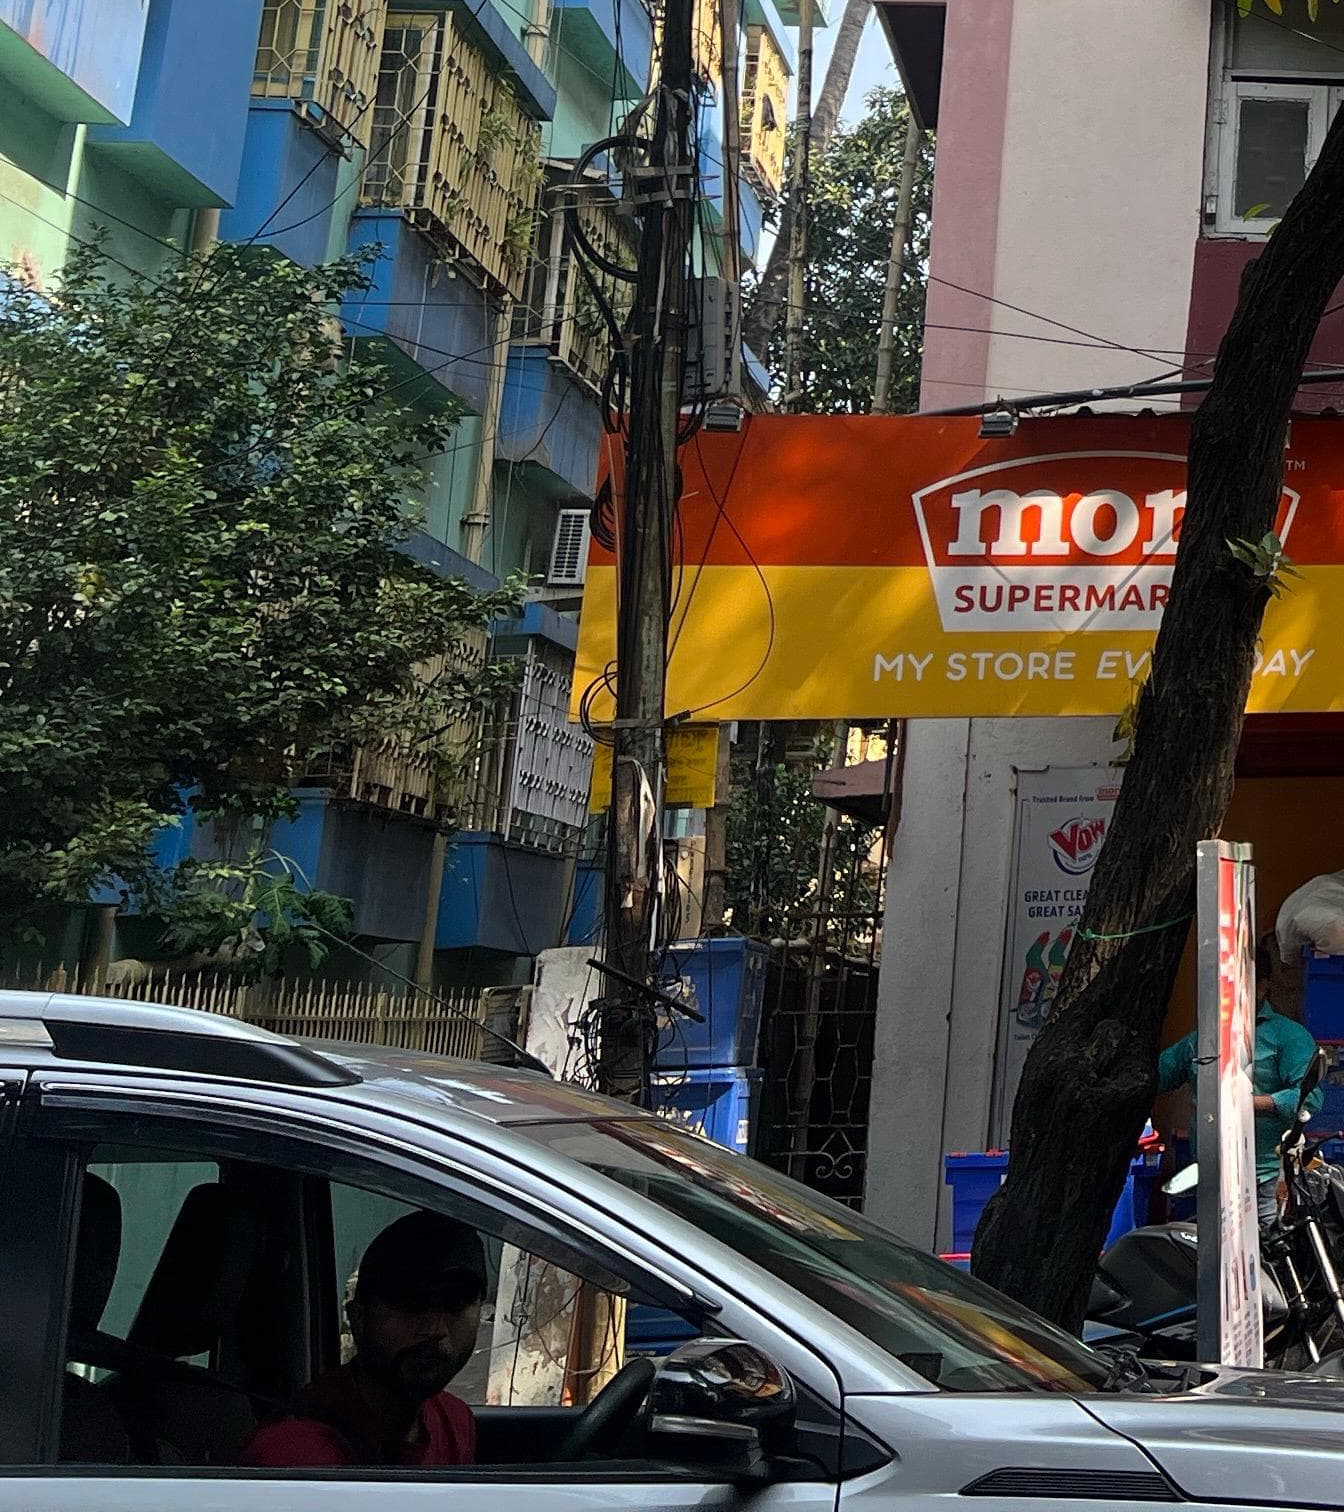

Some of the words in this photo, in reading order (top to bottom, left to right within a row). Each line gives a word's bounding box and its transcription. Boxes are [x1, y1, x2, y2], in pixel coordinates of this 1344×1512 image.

[946, 488, 1187, 557] mor
[955, 584, 1170, 613] SUPERMAR
[873, 651, 933, 683] MY
[947, 650, 1075, 681] STORE
[1033, 796, 1058, 804] Trusted
[1024, 890, 1061, 902] GREAT
[1063, 889, 1088, 901] CLEA
[1028, 905, 1064, 918] GREAT
